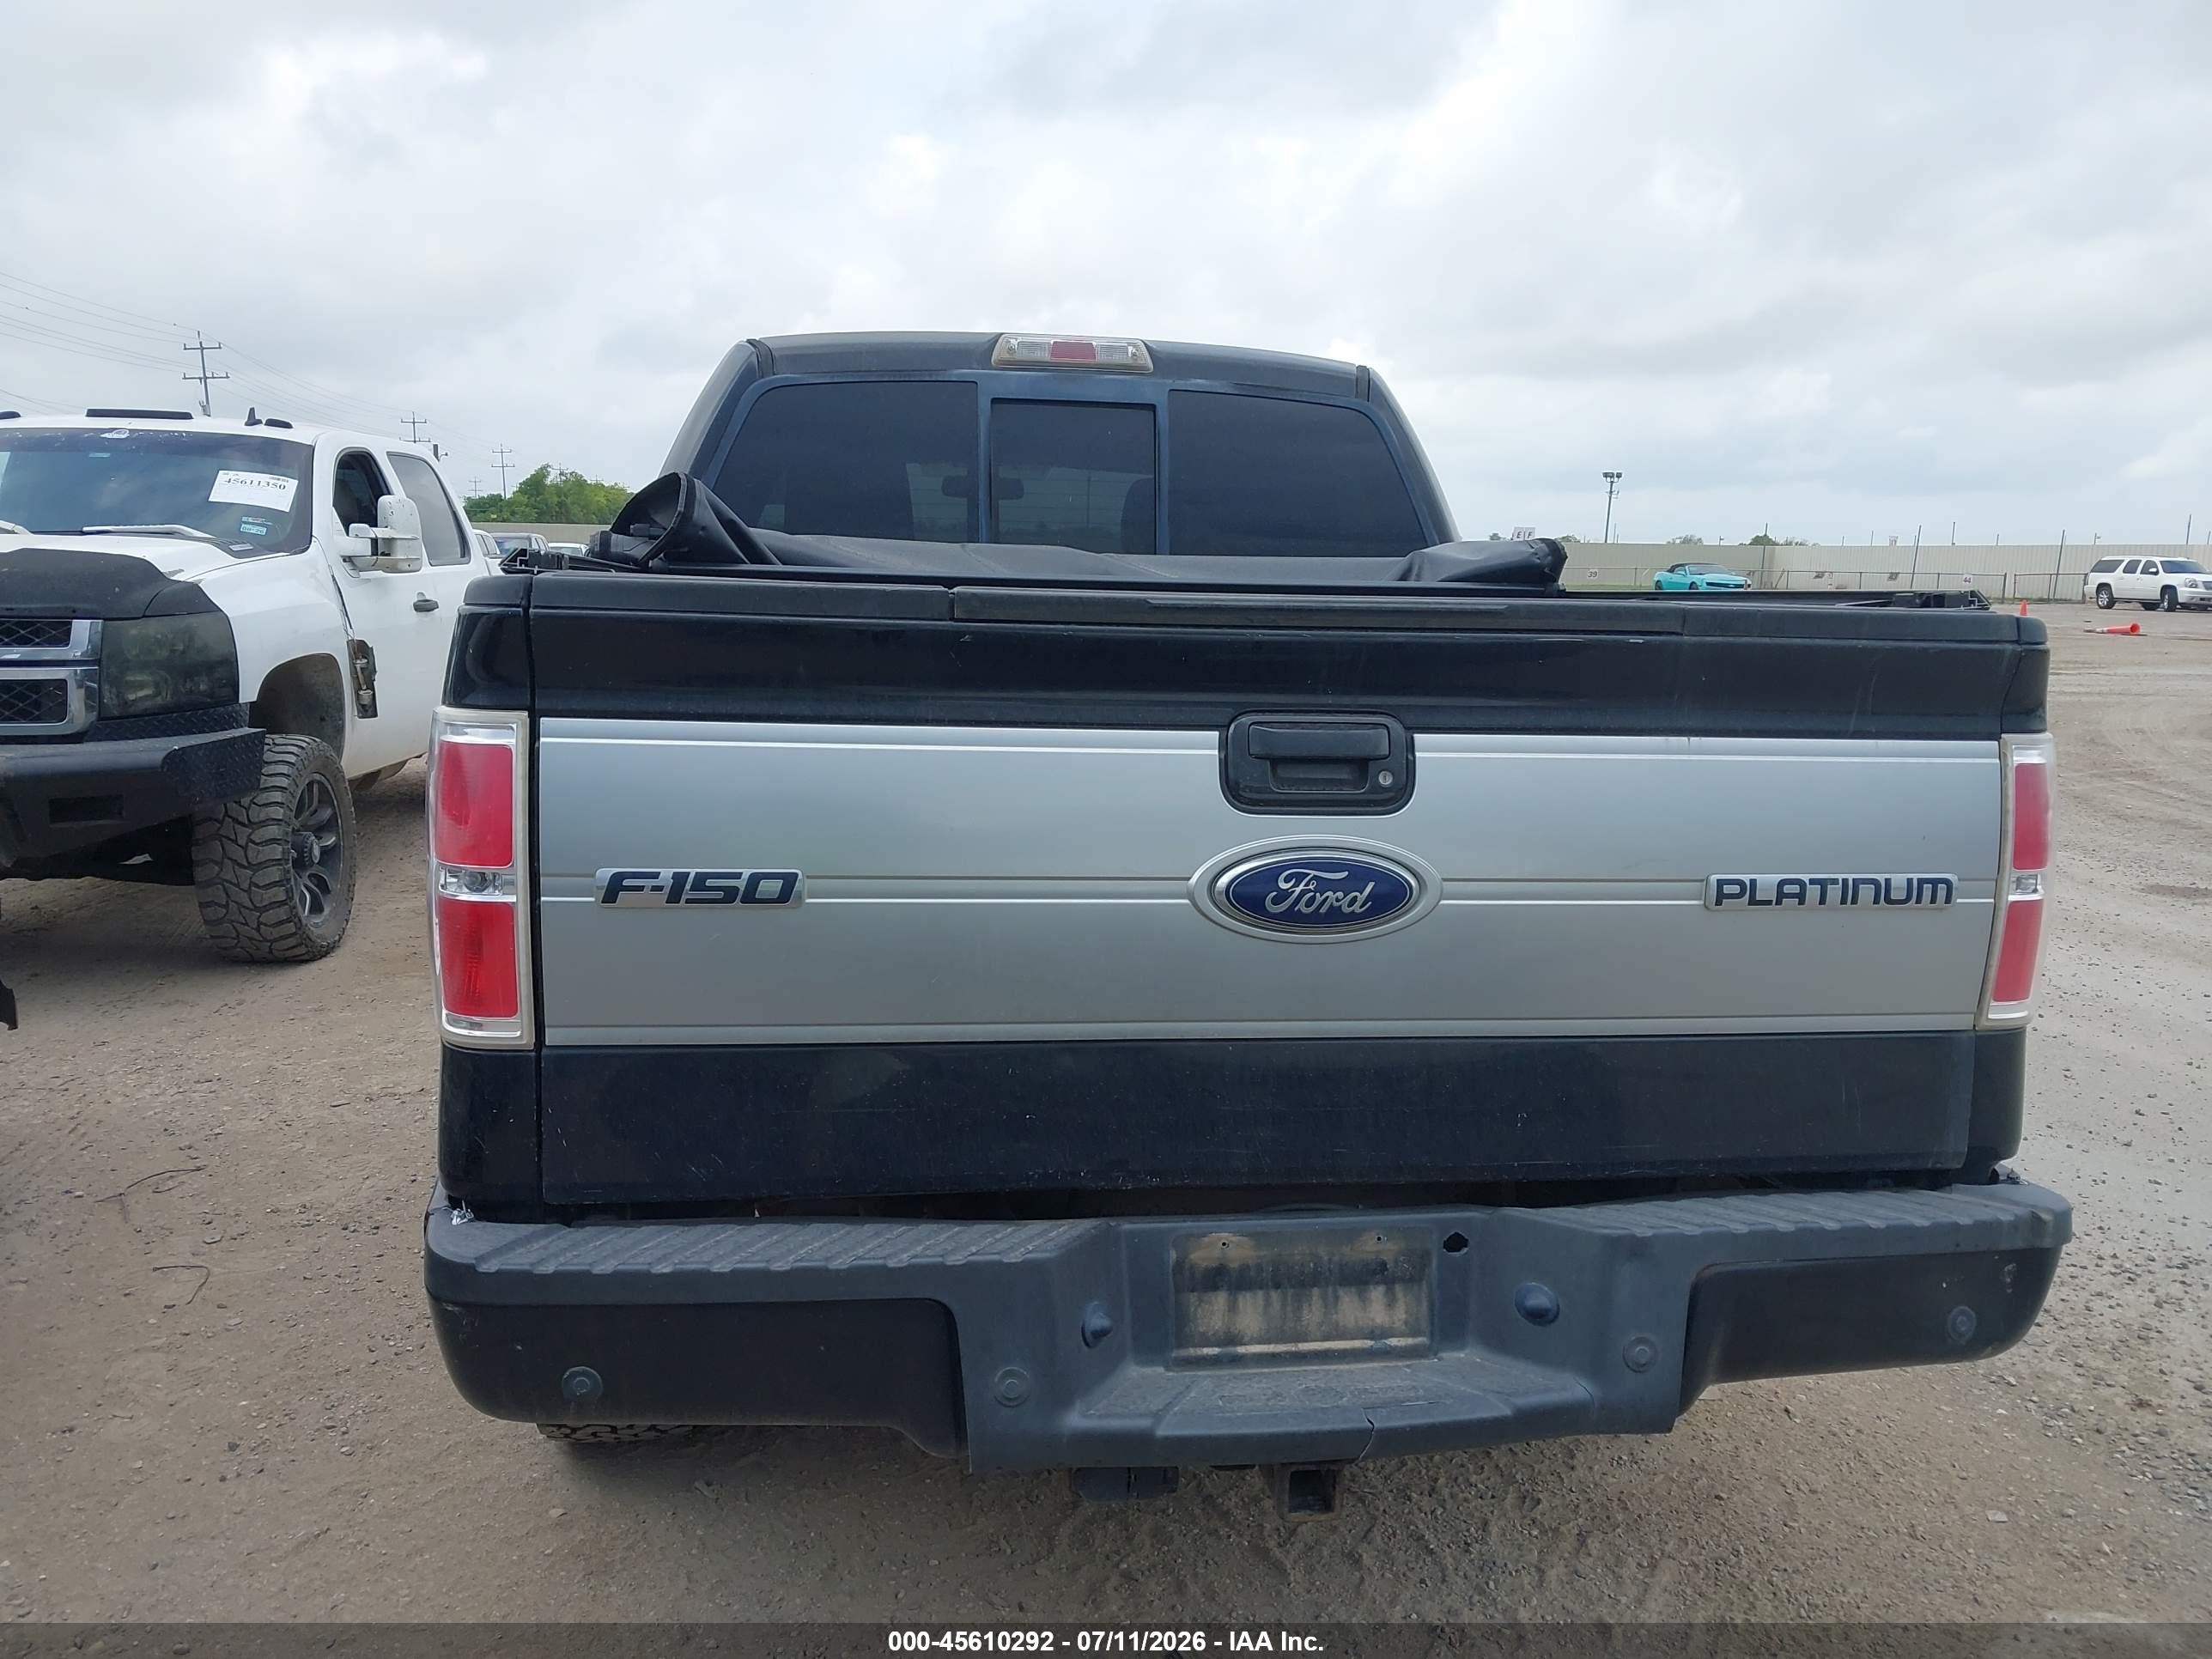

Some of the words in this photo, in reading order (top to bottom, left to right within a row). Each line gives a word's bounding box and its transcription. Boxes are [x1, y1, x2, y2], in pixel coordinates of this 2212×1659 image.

[223, 477, 286, 490] 45611350
[600, 871, 800, 904] F-150
[1264, 868, 1376, 915] Ford
[1714, 878, 1954, 907] PLATINUM
